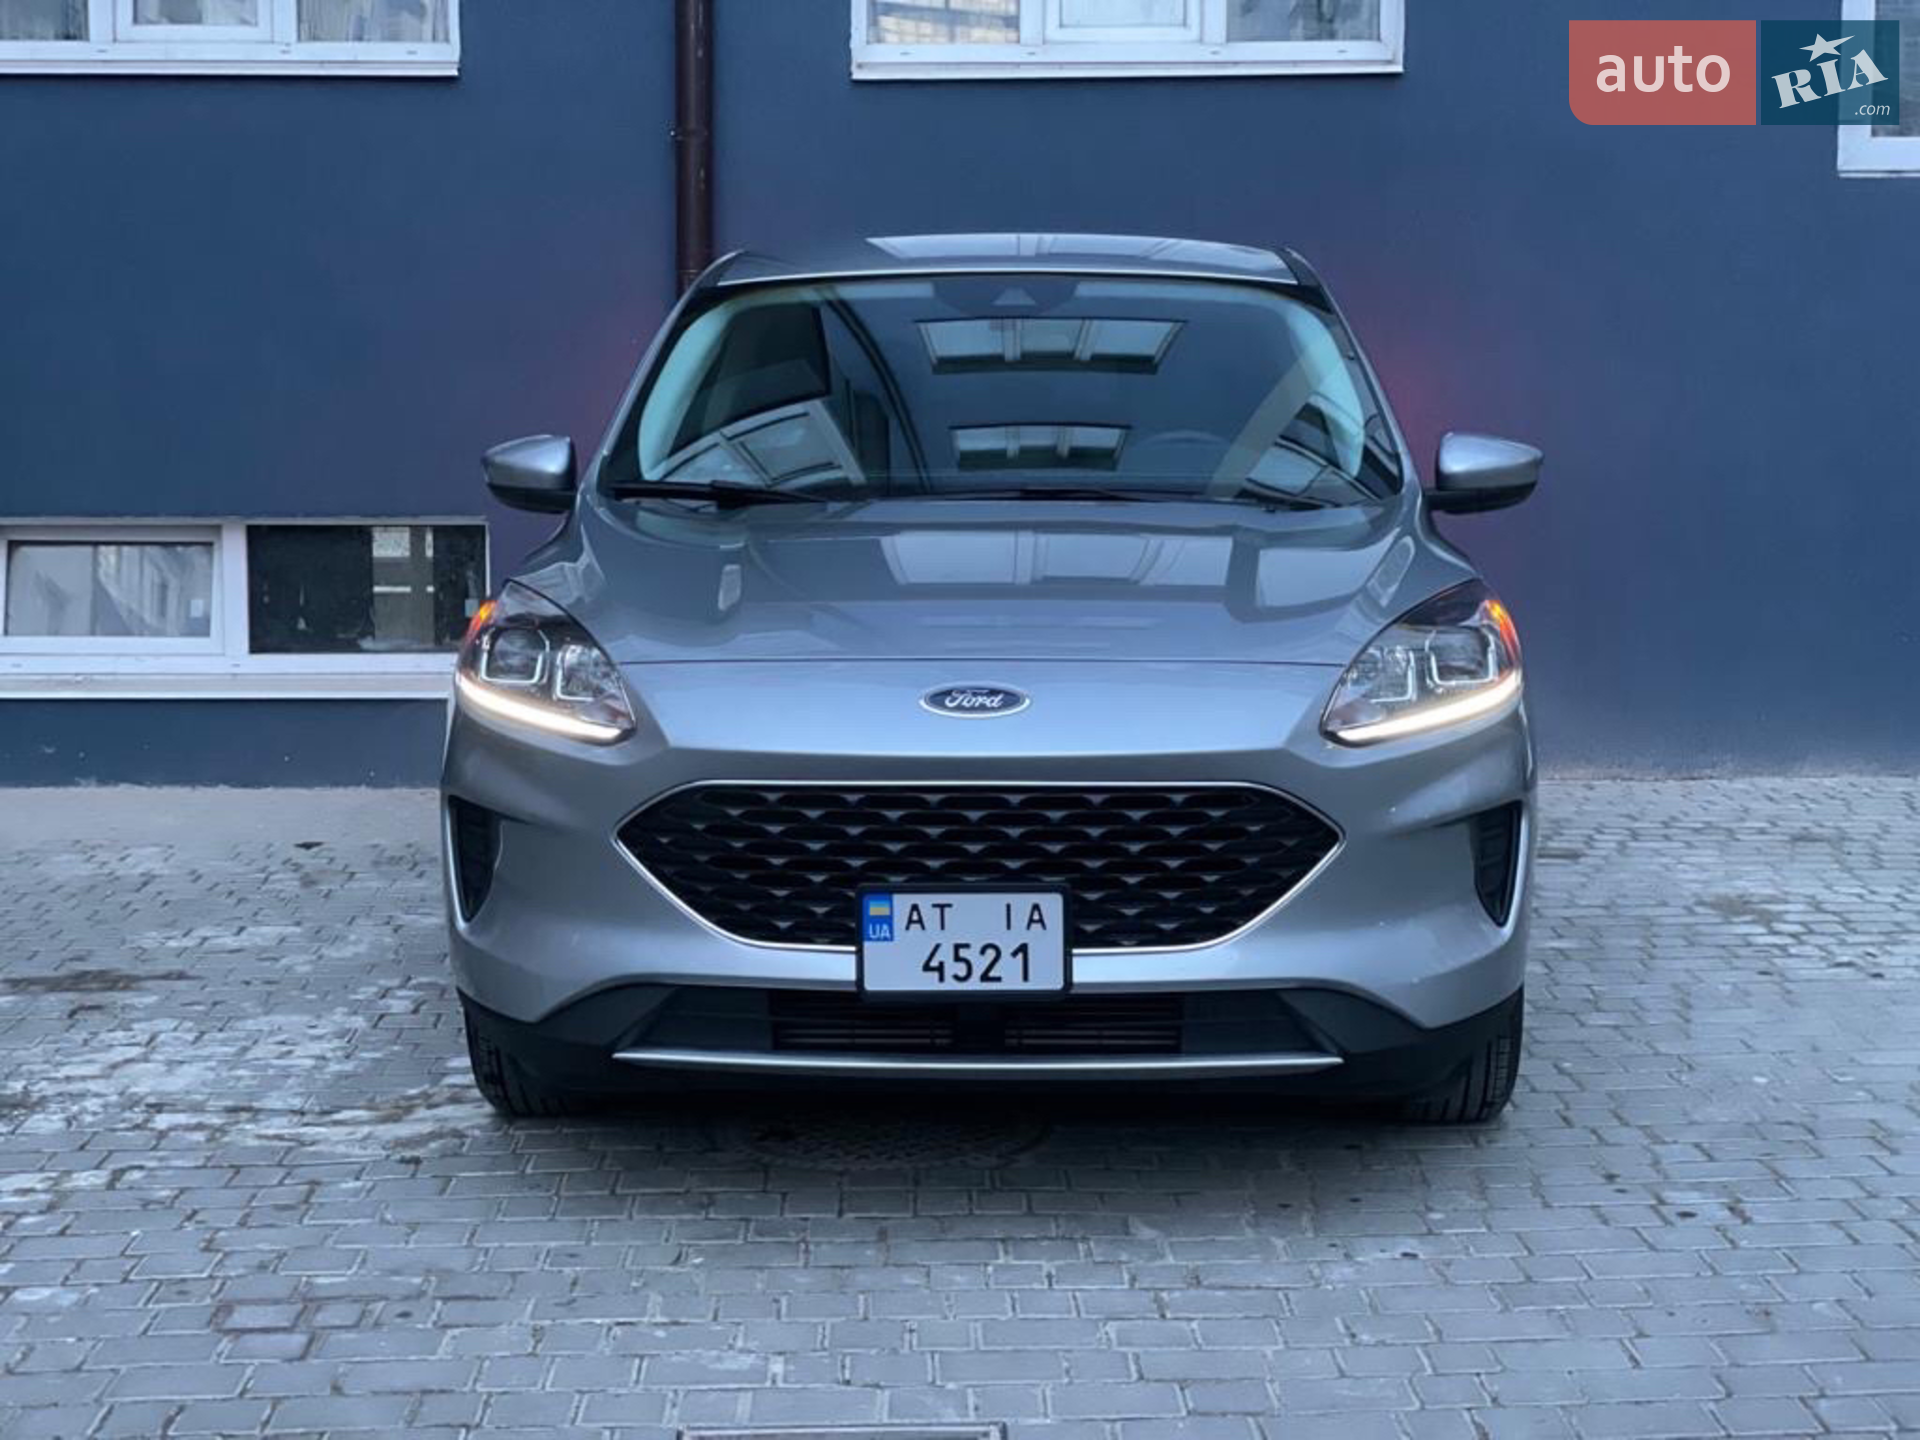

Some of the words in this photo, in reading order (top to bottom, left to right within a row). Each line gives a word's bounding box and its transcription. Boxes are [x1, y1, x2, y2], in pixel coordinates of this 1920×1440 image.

[944, 689, 1004, 708] Ford
[905, 903, 953, 931] AT
[1005, 903, 1047, 931] IA
[868, 924, 891, 939] UA
[922, 942, 1030, 983] 4521
